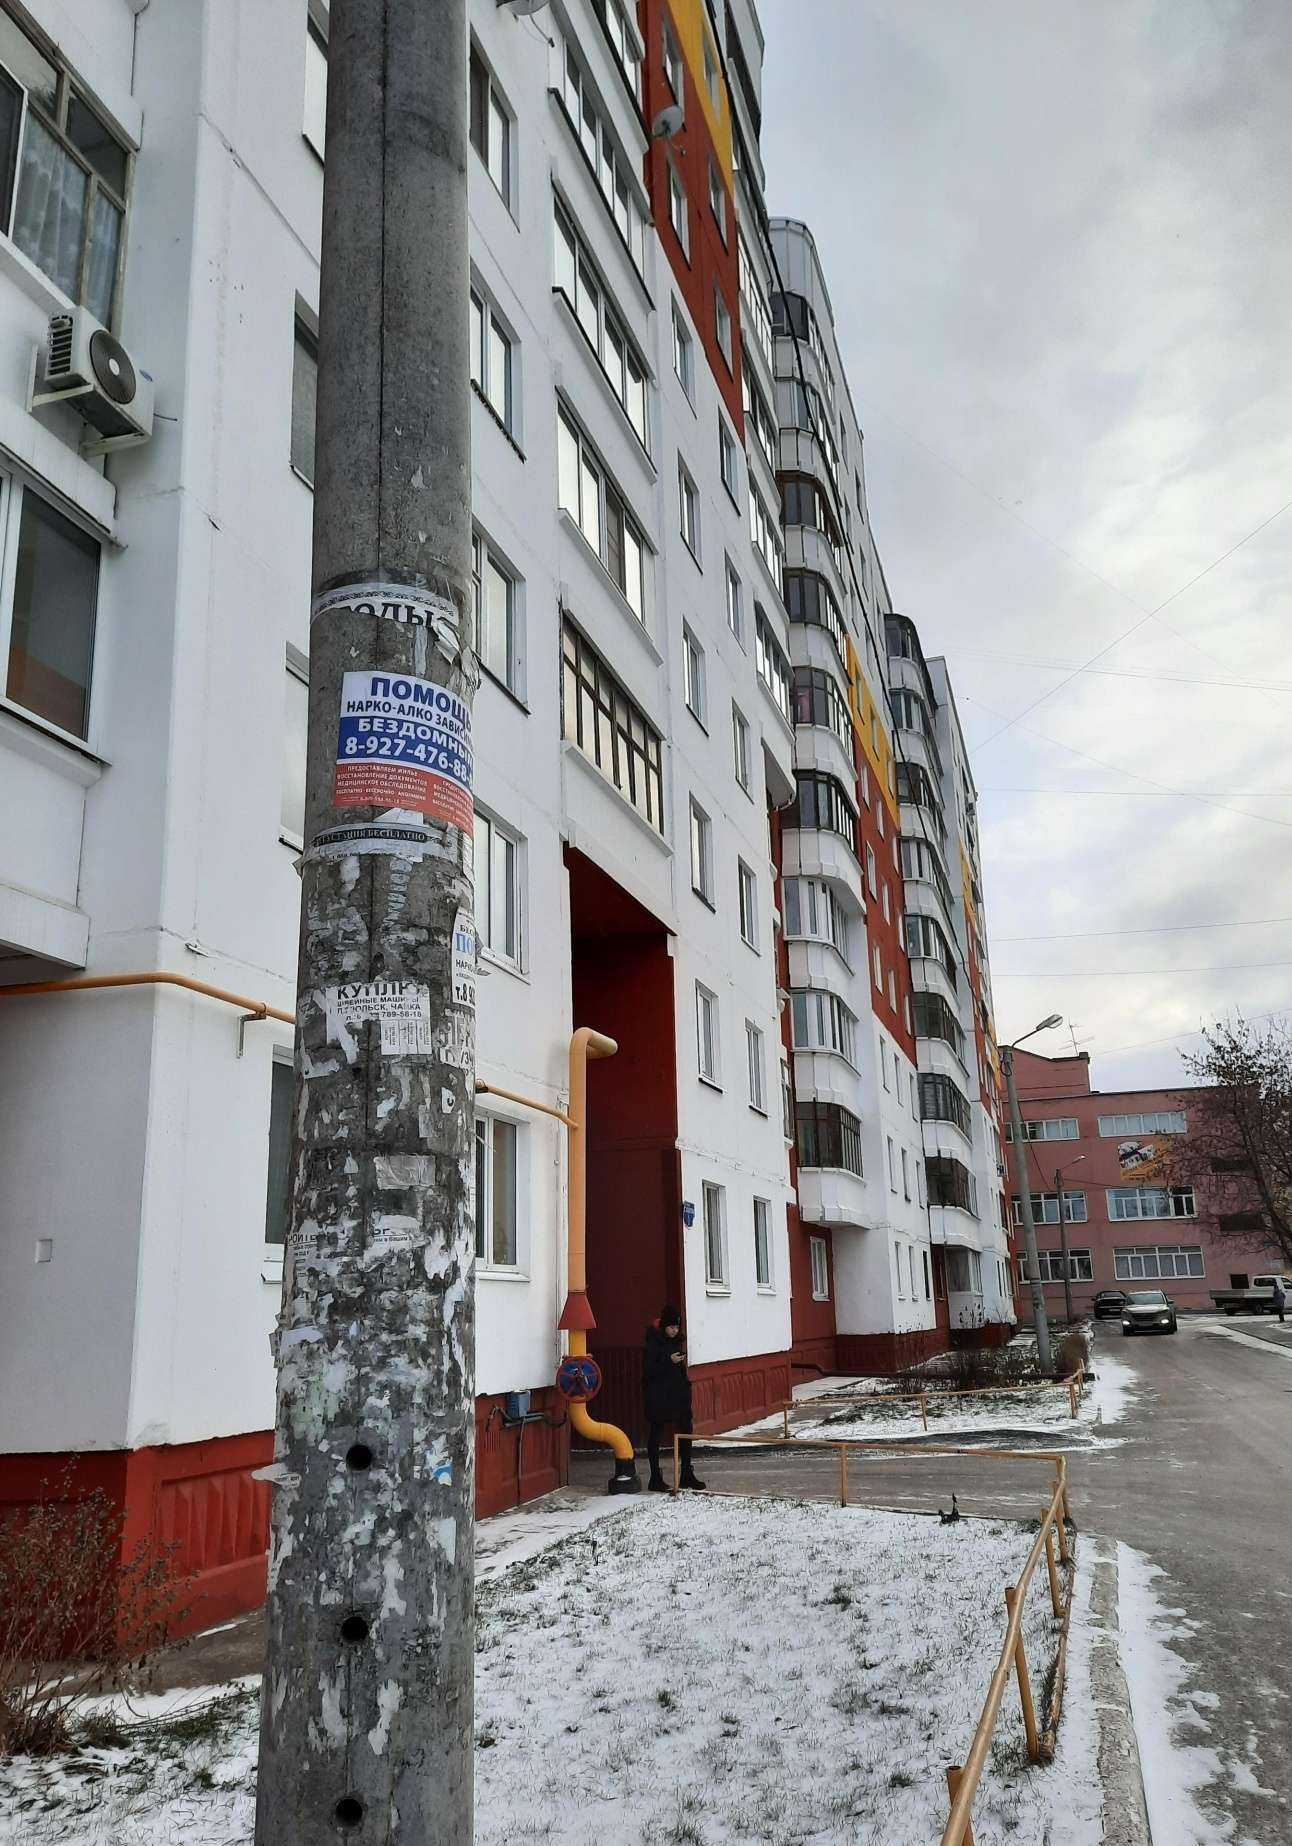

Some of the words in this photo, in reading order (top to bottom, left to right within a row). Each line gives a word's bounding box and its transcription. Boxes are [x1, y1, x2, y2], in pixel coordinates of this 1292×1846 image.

[346, 700, 433, 722] НАРКО-АЛКО
[370, 677, 472, 732] ПОМОЩЬ
[336, 772, 388, 780] ВОССТАНОВЛЕНИЕ
[389, 774, 428, 787] ДОКУМЕНТОВ
[368, 828, 425, 841] БЕСПЛАТНО
